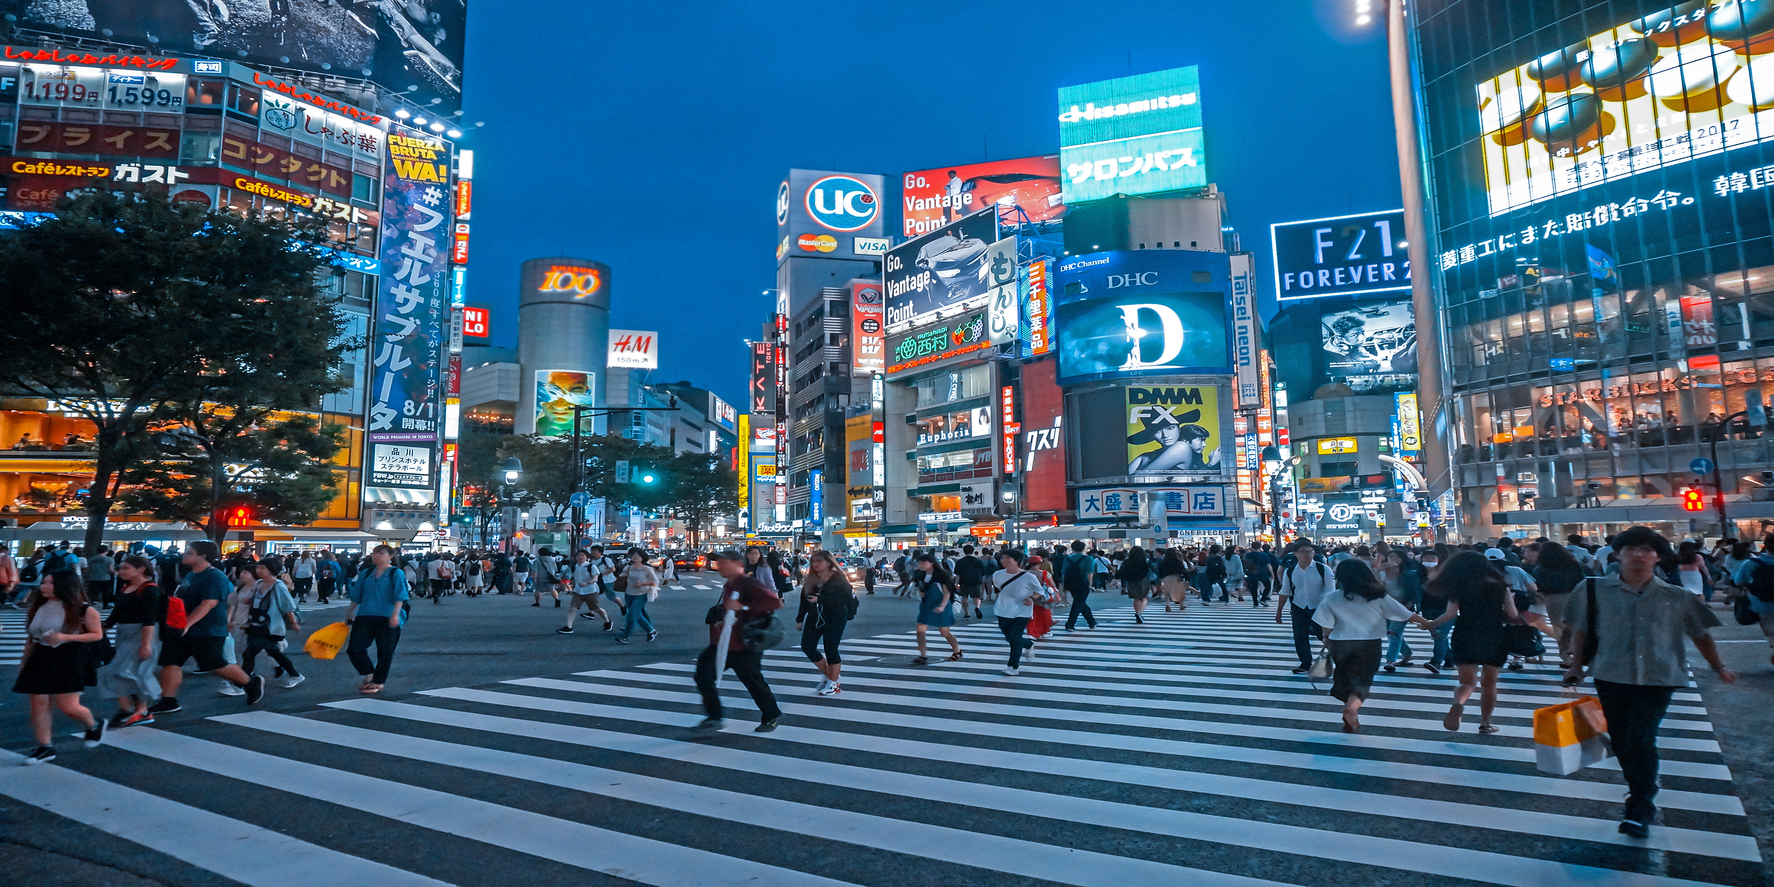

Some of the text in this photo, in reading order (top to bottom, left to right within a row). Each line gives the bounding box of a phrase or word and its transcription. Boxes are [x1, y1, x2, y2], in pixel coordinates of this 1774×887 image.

[25, 81, 99, 102] 1,199円
[108, 86, 183, 107] 1,599円
[1059, 92, 1197, 122] Hisamitsu
[20, 125, 174, 149] プライス
[304, 114, 378, 154] しゃぶ葉
[388, 134, 447, 152] FUERZA
[389, 144, 438, 160] BRUTA
[223, 138, 347, 188] コンタクト
[392, 159, 448, 183] WA!
[1067, 147, 1197, 184] サロンパス
[114, 163, 189, 184] ガスト
[904, 173, 931, 189] Go,
[312, 198, 369, 223] ガスト
[904, 192, 973, 211] Vantage
[797, 239, 838, 248] MasterCard
[859, 242, 887, 251] VISA
[551, 265, 600, 275] SHIBUYA
[886, 254, 904, 272] Go,
[1060, 257, 1110, 272] DHC Channel
[538, 271, 601, 299] 109
[886, 271, 931, 299] Vantage
[1107, 271, 1158, 289] DHC
[1284, 262, 1396, 290] FOREVER
[887, 300, 918, 326] Point.
[1029, 266, 1044, 350] 三千里薬品
[1233, 271, 1251, 367] Taisei neon
[614, 335, 652, 354] H&M
[918, 333, 948, 356] 西村
[1128, 387, 1203, 405] DMM
[403, 399, 434, 418] 8/1
[1129, 406, 1179, 424] FX
[402, 417, 435, 432] 開幕!!
[919, 428, 970, 444] Euphoria
[975, 450, 992, 465] JTB
